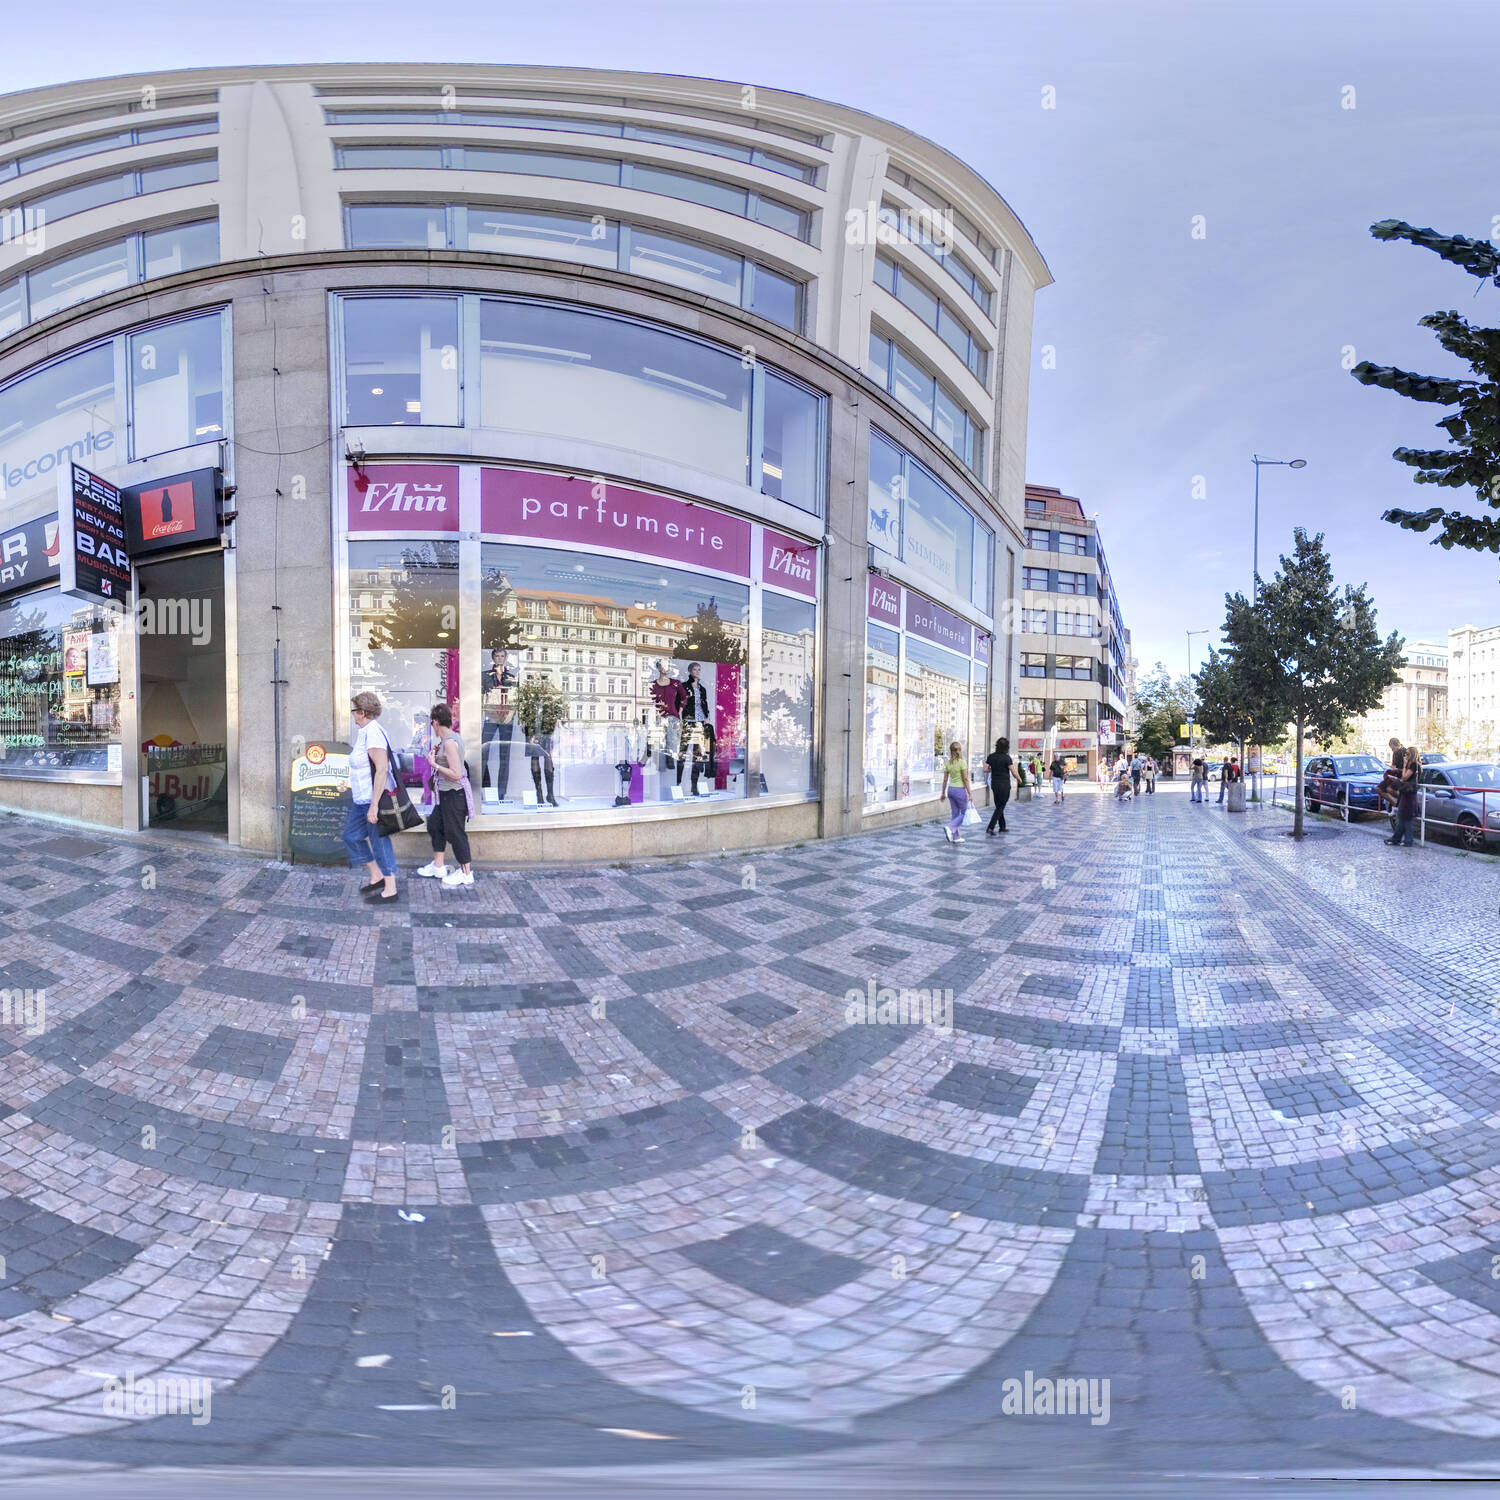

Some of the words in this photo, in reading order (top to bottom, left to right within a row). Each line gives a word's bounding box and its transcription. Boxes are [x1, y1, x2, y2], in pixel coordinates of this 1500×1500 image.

[3, 431, 115, 490] lecomte
[74, 483, 122, 514] FACTOR
[76, 508, 106, 529] NEW
[108, 525, 123, 539] AG
[522, 496, 725, 551] parfumerie
[0, 532, 28, 566] R
[76, 531, 130, 572] BAR
[77, 554, 109, 573] MUSIC
[109, 567, 131, 582] CLUB
[914, 613, 966, 645] parfumerie
[165, 774, 210, 801] Bull
